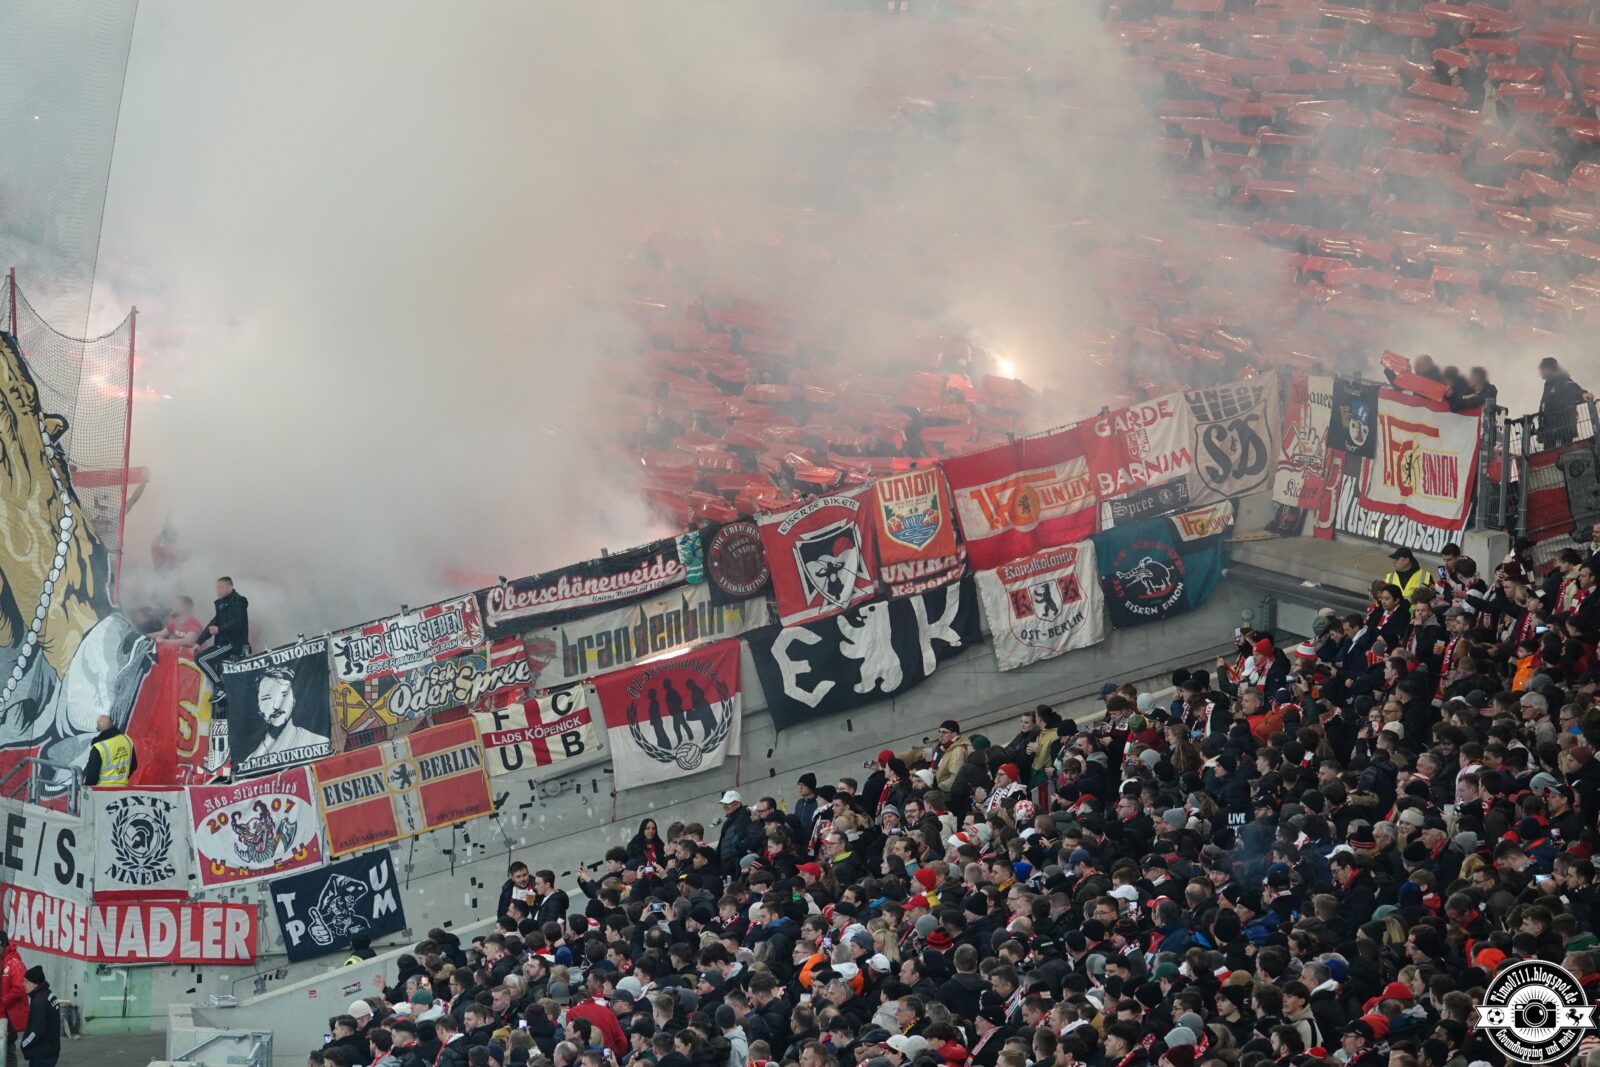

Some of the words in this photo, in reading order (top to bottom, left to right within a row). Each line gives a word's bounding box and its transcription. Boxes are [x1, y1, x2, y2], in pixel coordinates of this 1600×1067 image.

[1095, 400, 1173, 437] GARDE
[878, 469, 937, 503] UNION
[1097, 446, 1192, 496] BARNIM
[1422, 452, 1458, 499] UNION
[823, 498, 856, 508] BIKER
[1112, 497, 1155, 519] Spree
[713, 535, 724, 550] DIE
[723, 525, 760, 540] ÜBLICHEN
[881, 545, 967, 584] UNIKA
[486, 553, 681, 620] Oberschöneweide
[1124, 600, 1158, 615] EISERN
[1162, 582, 1184, 611] UNION
[350, 634, 382, 663] EINS
[384, 623, 419, 657] FÜNF
[418, 609, 463, 645] SIEBEN
[1021, 611, 1084, 640] OST-BERLIN
[222, 658, 269, 674] EINMAL
[270, 641, 326, 665] UNIONER
[387, 676, 454, 717] Oder
[454, 660, 531, 705] Spree
[491, 731, 522, 746] LADS
[525, 716, 582, 740] KÖPENICK
[280, 743, 331, 764] UNIONE
[322, 772, 386, 807] EISERN
[418, 745, 480, 781] BERLIN
[105, 796, 177, 815] SIXTY
[207, 812, 229, 835] 20
[271, 798, 296, 814] 07
[1228, 812, 1246, 824] LIVE
[104, 863, 176, 885] NINERS
[3, 886, 251, 960] SACHSENADLER
